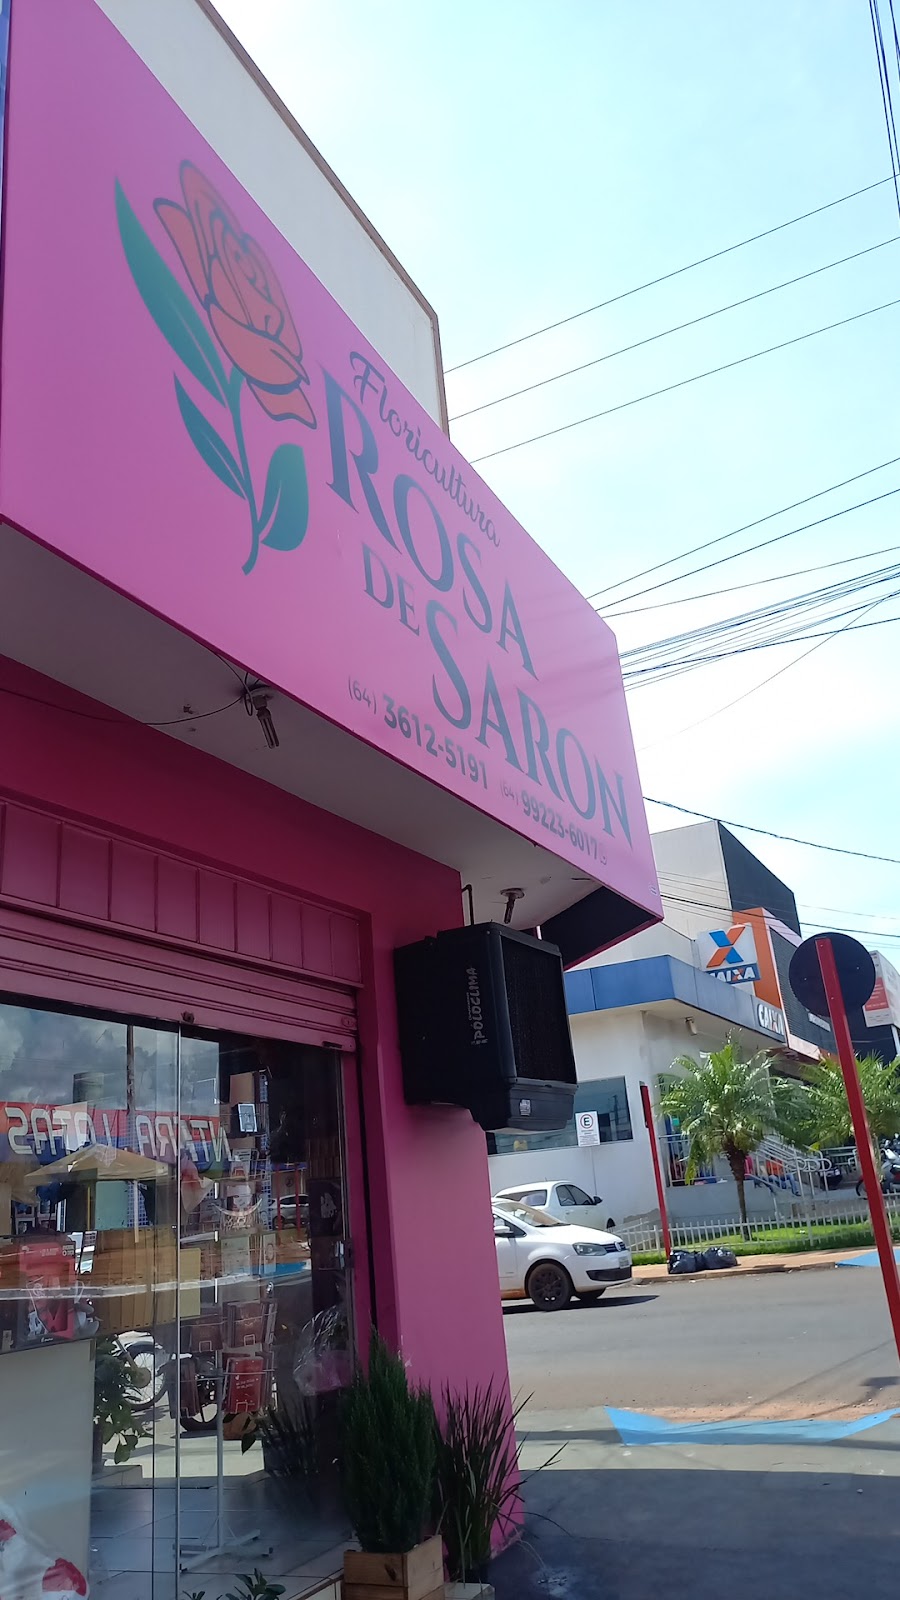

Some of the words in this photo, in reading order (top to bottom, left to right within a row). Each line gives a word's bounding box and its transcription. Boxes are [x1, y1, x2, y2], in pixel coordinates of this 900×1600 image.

[317, 360, 539, 681] ROSA
[350, 351, 500, 548] Floricultura
[348, 675, 377, 715] (64)
[382, 692, 488, 790] 3612-5191
[499, 778, 519, 806] (64)
[521, 789, 598, 860] 99223-6017
[361, 540, 420, 636] DE
[425, 600, 633, 850] SARON
[583, 1116, 591, 1127] E
